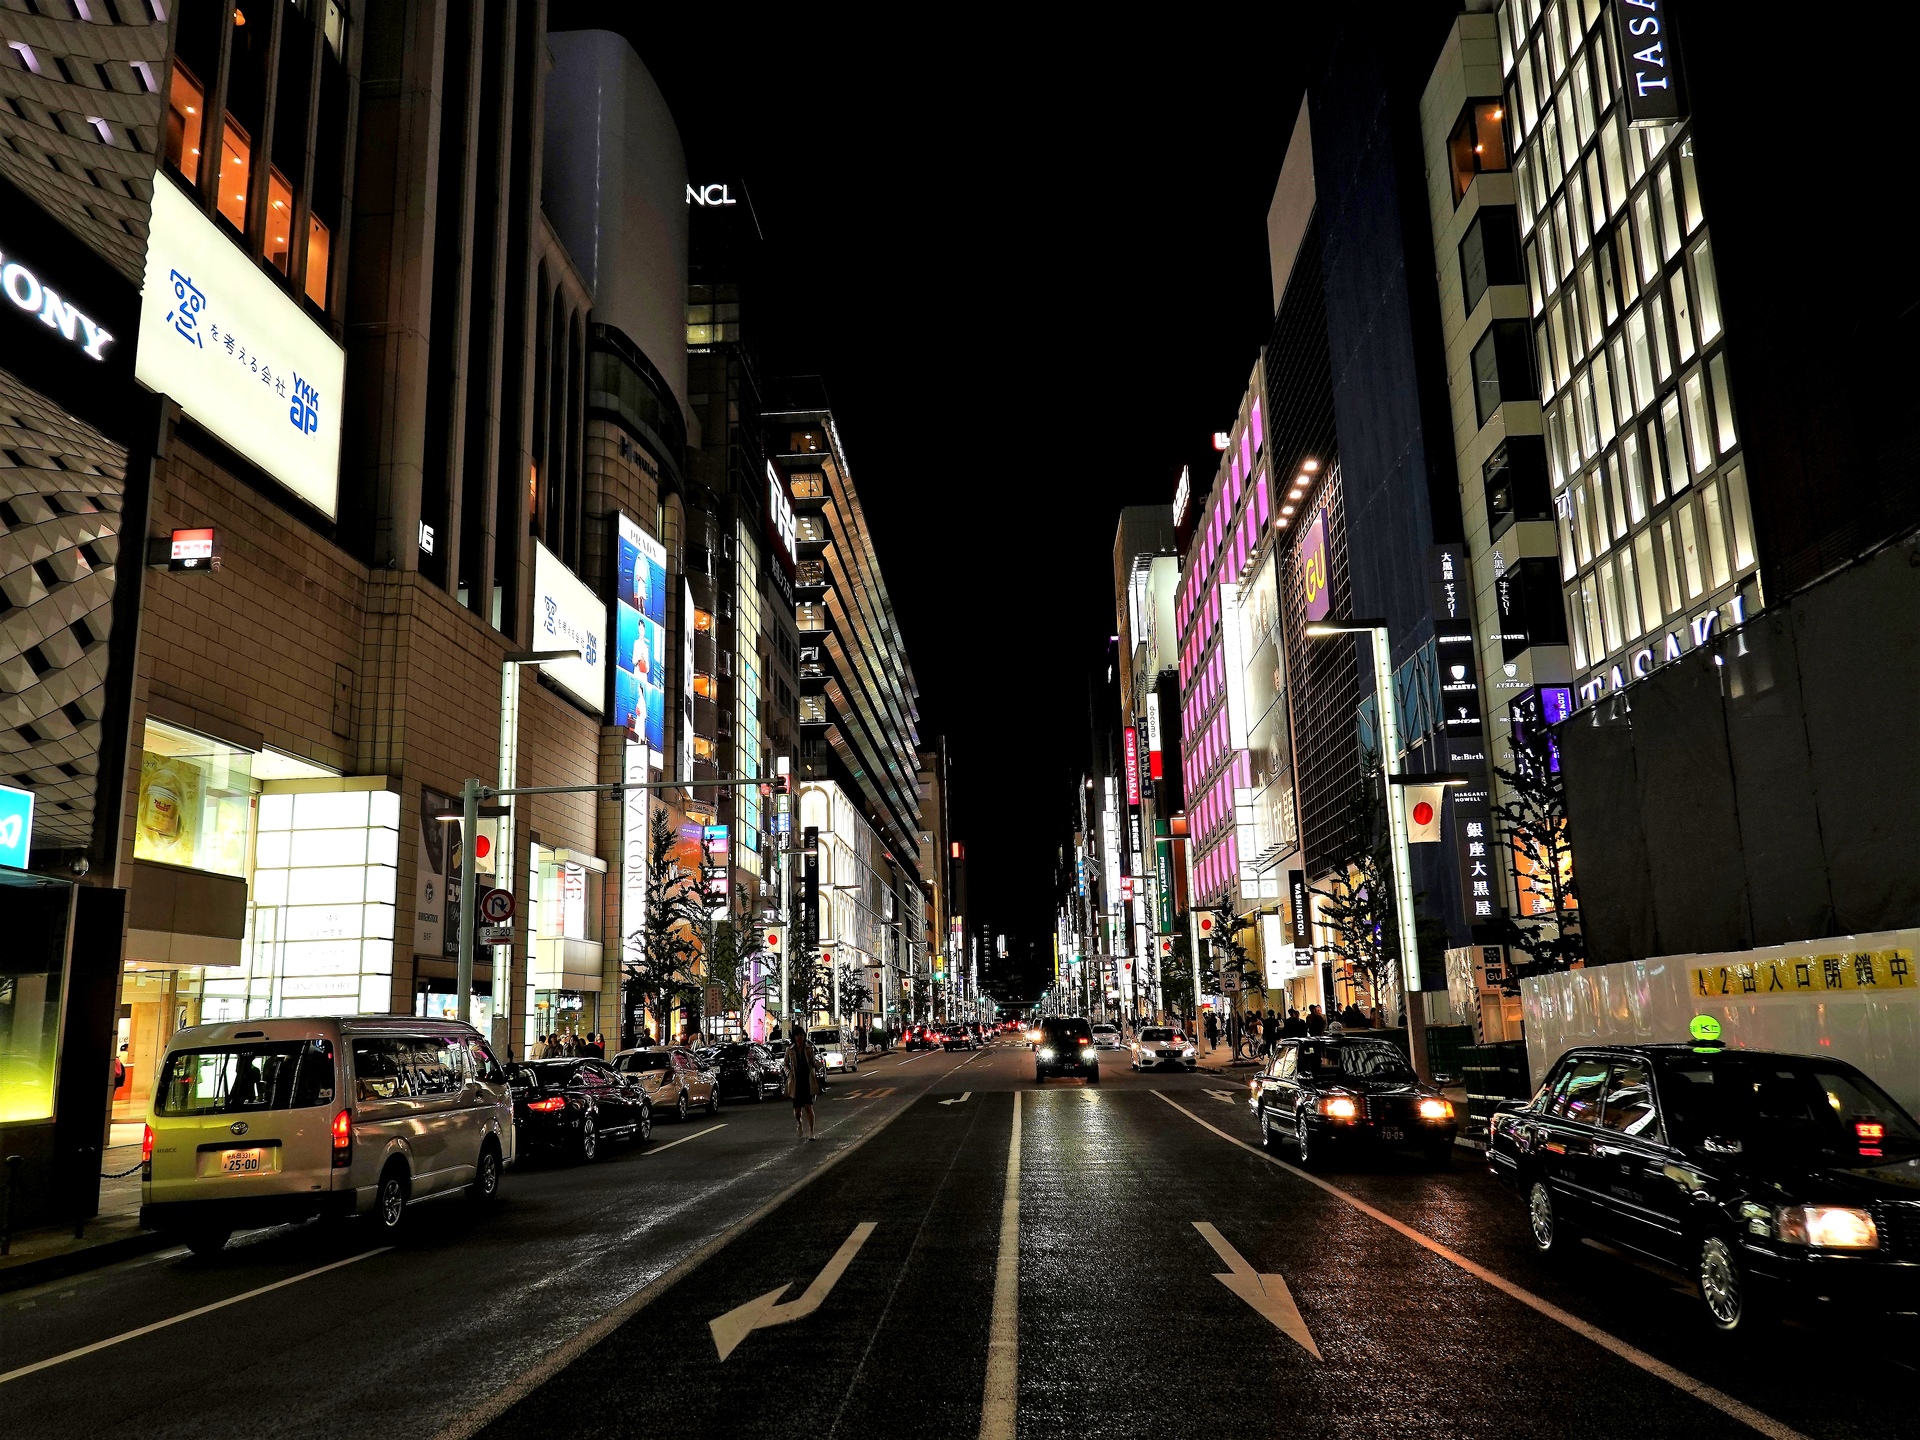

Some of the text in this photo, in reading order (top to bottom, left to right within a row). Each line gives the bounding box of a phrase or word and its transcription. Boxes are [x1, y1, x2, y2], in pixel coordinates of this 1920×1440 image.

[686, 183, 737, 206] NCL
[0, 252, 115, 361] ONY
[291, 370, 320, 412] YKK
[1305, 541, 1325, 604] GU
[1149, 706, 1157, 738] docomo
[1451, 752, 1485, 761] Re:Birth
[629, 765, 644, 832] GNZA
[1466, 822, 1491, 916] 銀座大黒屋
[1294, 882, 1305, 936] WASHINGTON
[1486, 972, 1502, 981] GU
